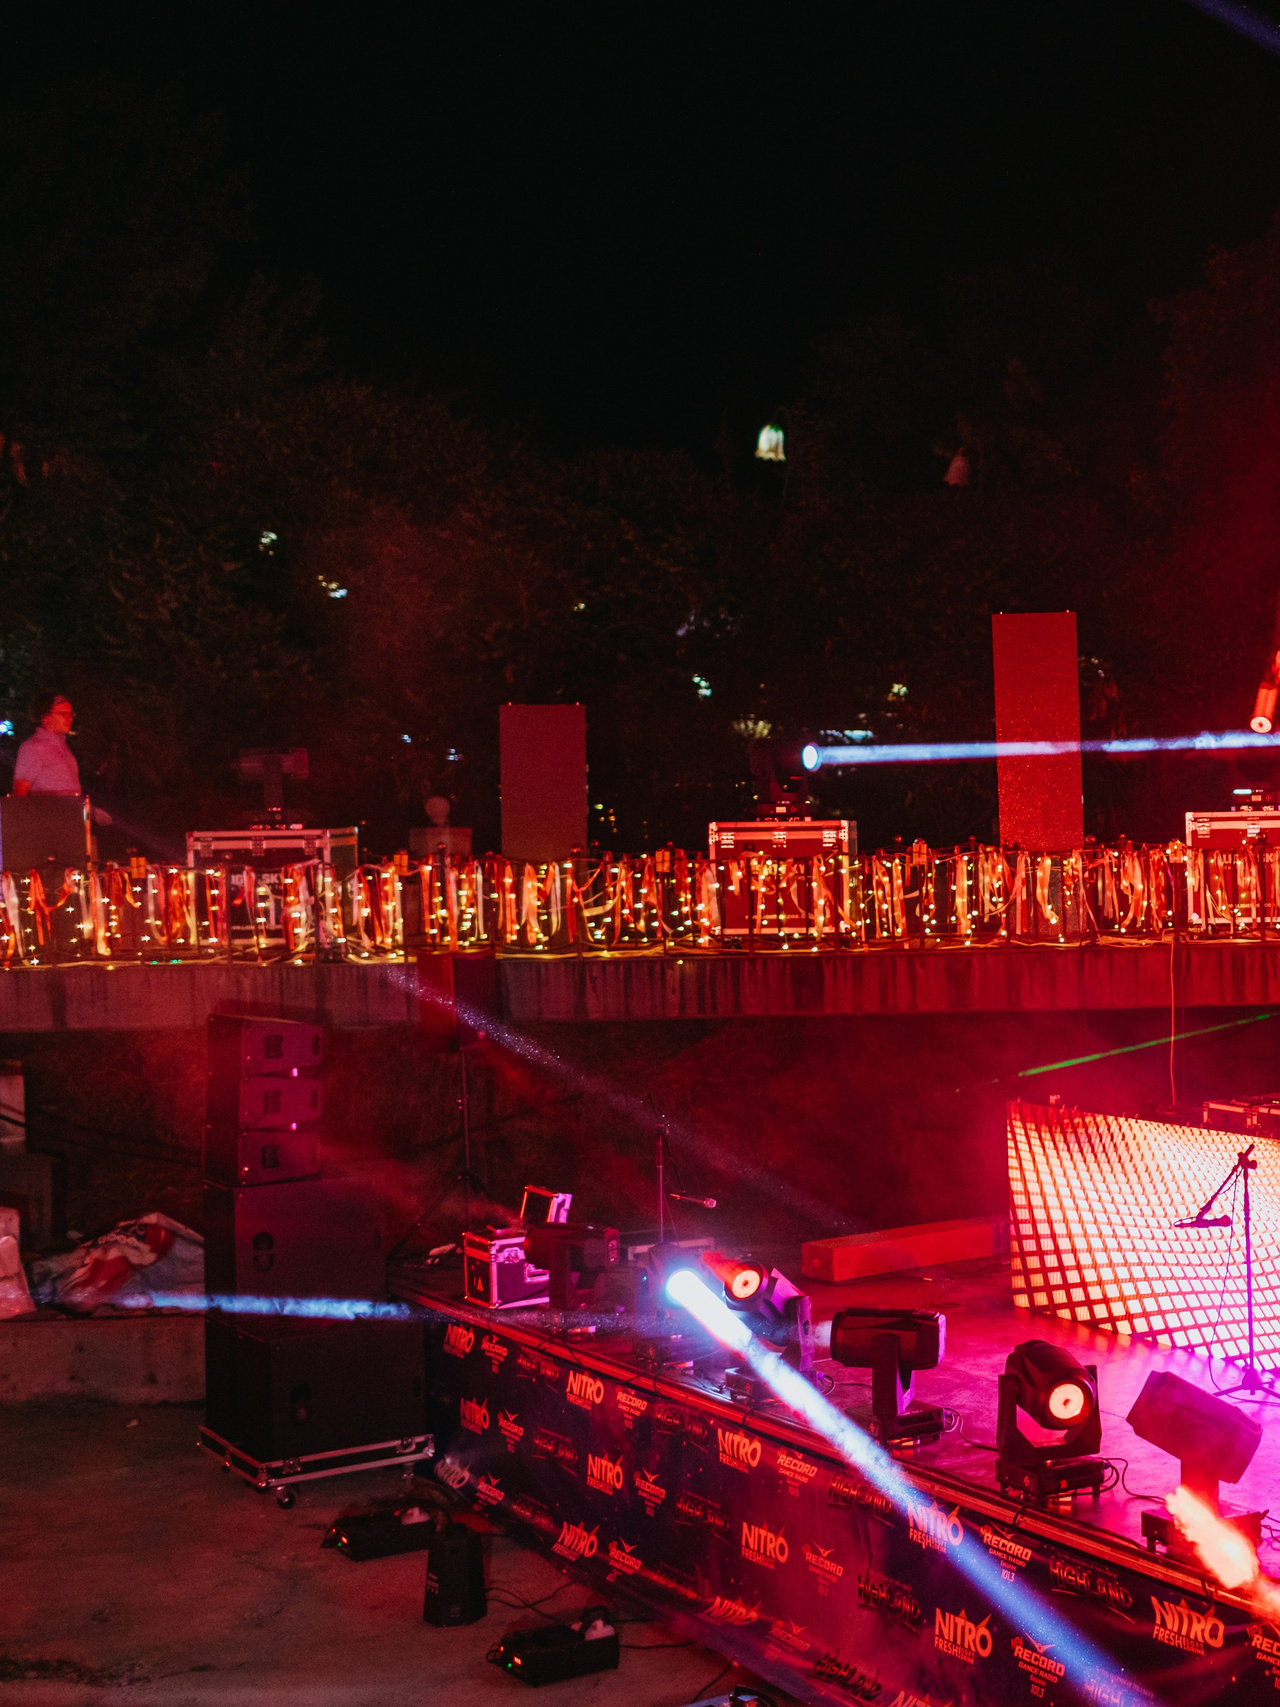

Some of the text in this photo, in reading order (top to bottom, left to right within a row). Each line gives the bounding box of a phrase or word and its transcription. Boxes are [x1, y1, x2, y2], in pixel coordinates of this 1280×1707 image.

[445, 1323, 475, 1354] NITRO
[566, 1370, 605, 1404] NITRO
[616, 1390, 648, 1412] RECORD
[460, 1397, 490, 1430] NITRO
[498, 1418, 525, 1437] RECORD
[717, 1428, 762, 1468] NITRO
[587, 1453, 624, 1490] NITRO
[776, 1454, 818, 1478] RECORD
[779, 1467, 809, 1484] DANCE RADIO
[477, 1481, 505, 1501] RECORD
[634, 1478, 666, 1498] RECORD
[558, 1520, 598, 1558] NITRO
[907, 1501, 964, 1547] NITRO
[741, 1521, 789, 1564] NITRO
[983, 1532, 1032, 1562] RECORD
[988, 1547, 1026, 1568] DANCE RADIO
[608, 1548, 643, 1570] RECORD
[805, 1552, 844, 1577] RECORD
[934, 1607, 993, 1658] NITRO
[1150, 1595, 1225, 1648] NITRO
[769, 1627, 811, 1650] RECORD
[1013, 1646, 1066, 1677] RECORD
[1018, 1661, 1058, 1684] DANCE RADIO
